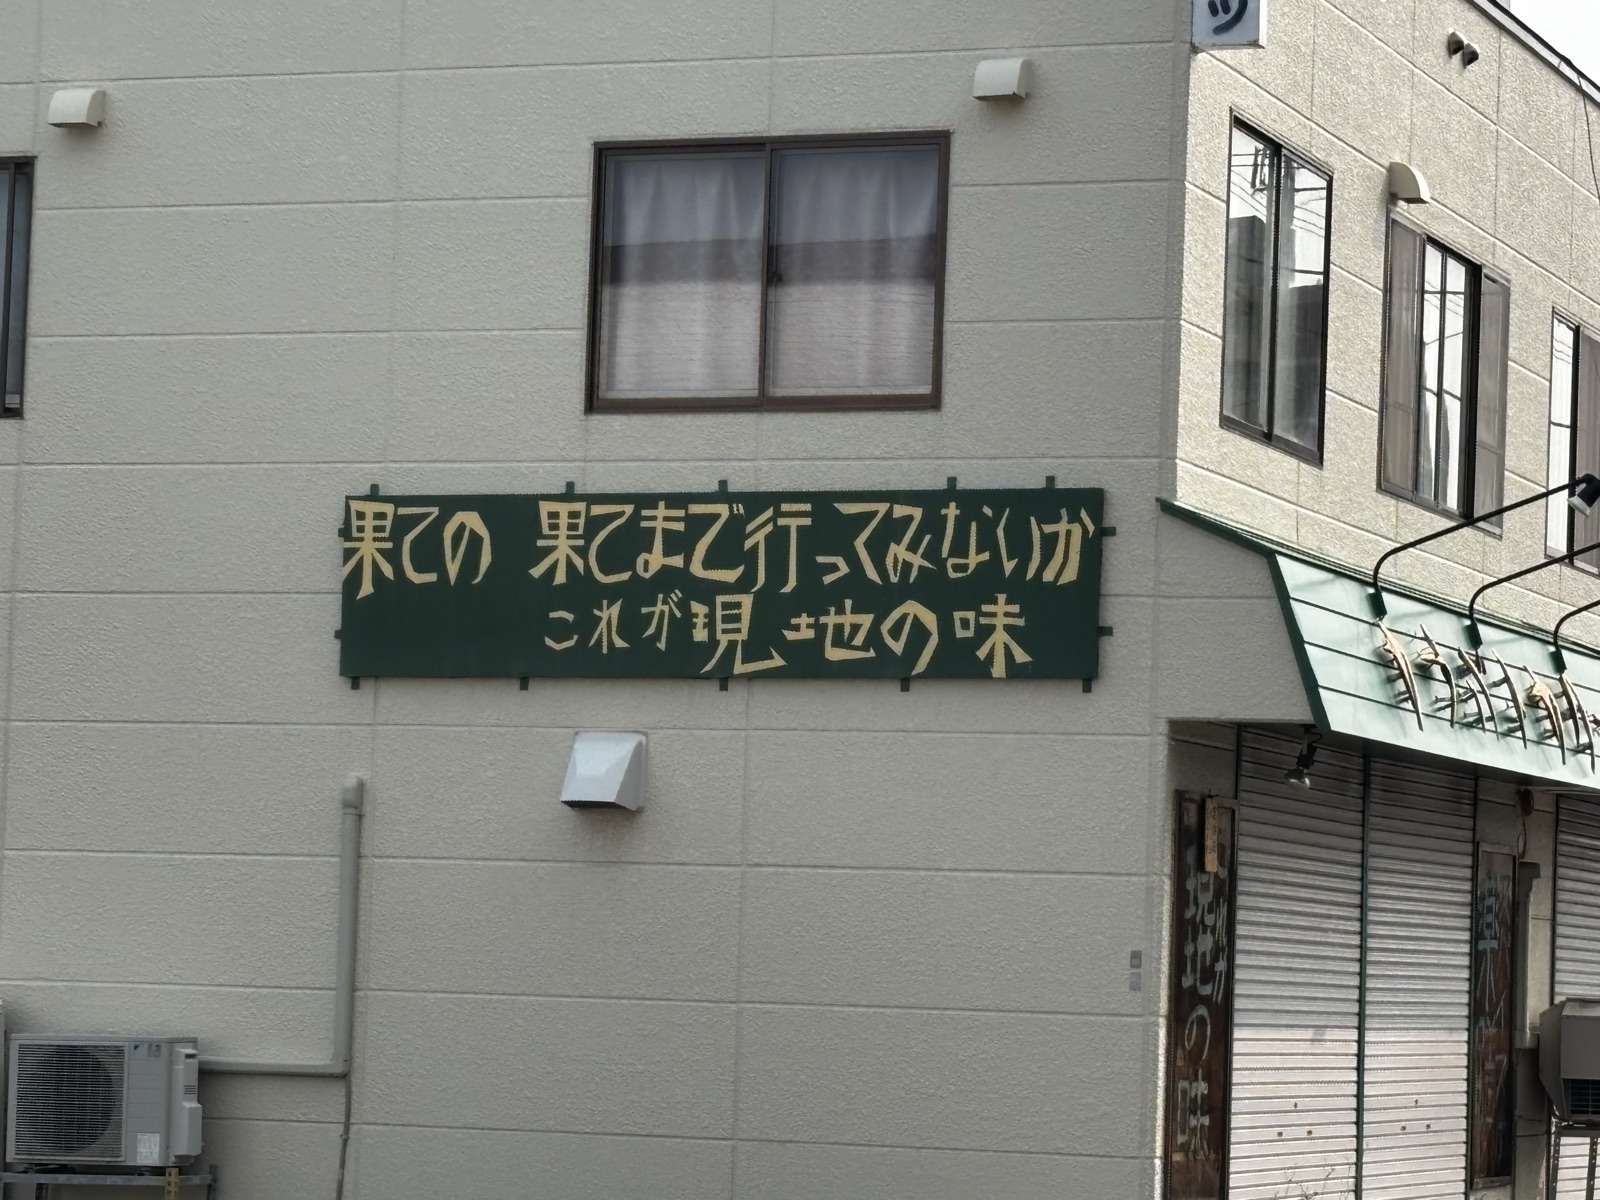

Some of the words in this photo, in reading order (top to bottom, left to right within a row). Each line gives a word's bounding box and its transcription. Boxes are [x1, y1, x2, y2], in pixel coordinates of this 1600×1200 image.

[342, 499, 492, 600] 果ての
[528, 499, 1095, 593] 果てまで行ってみないか
